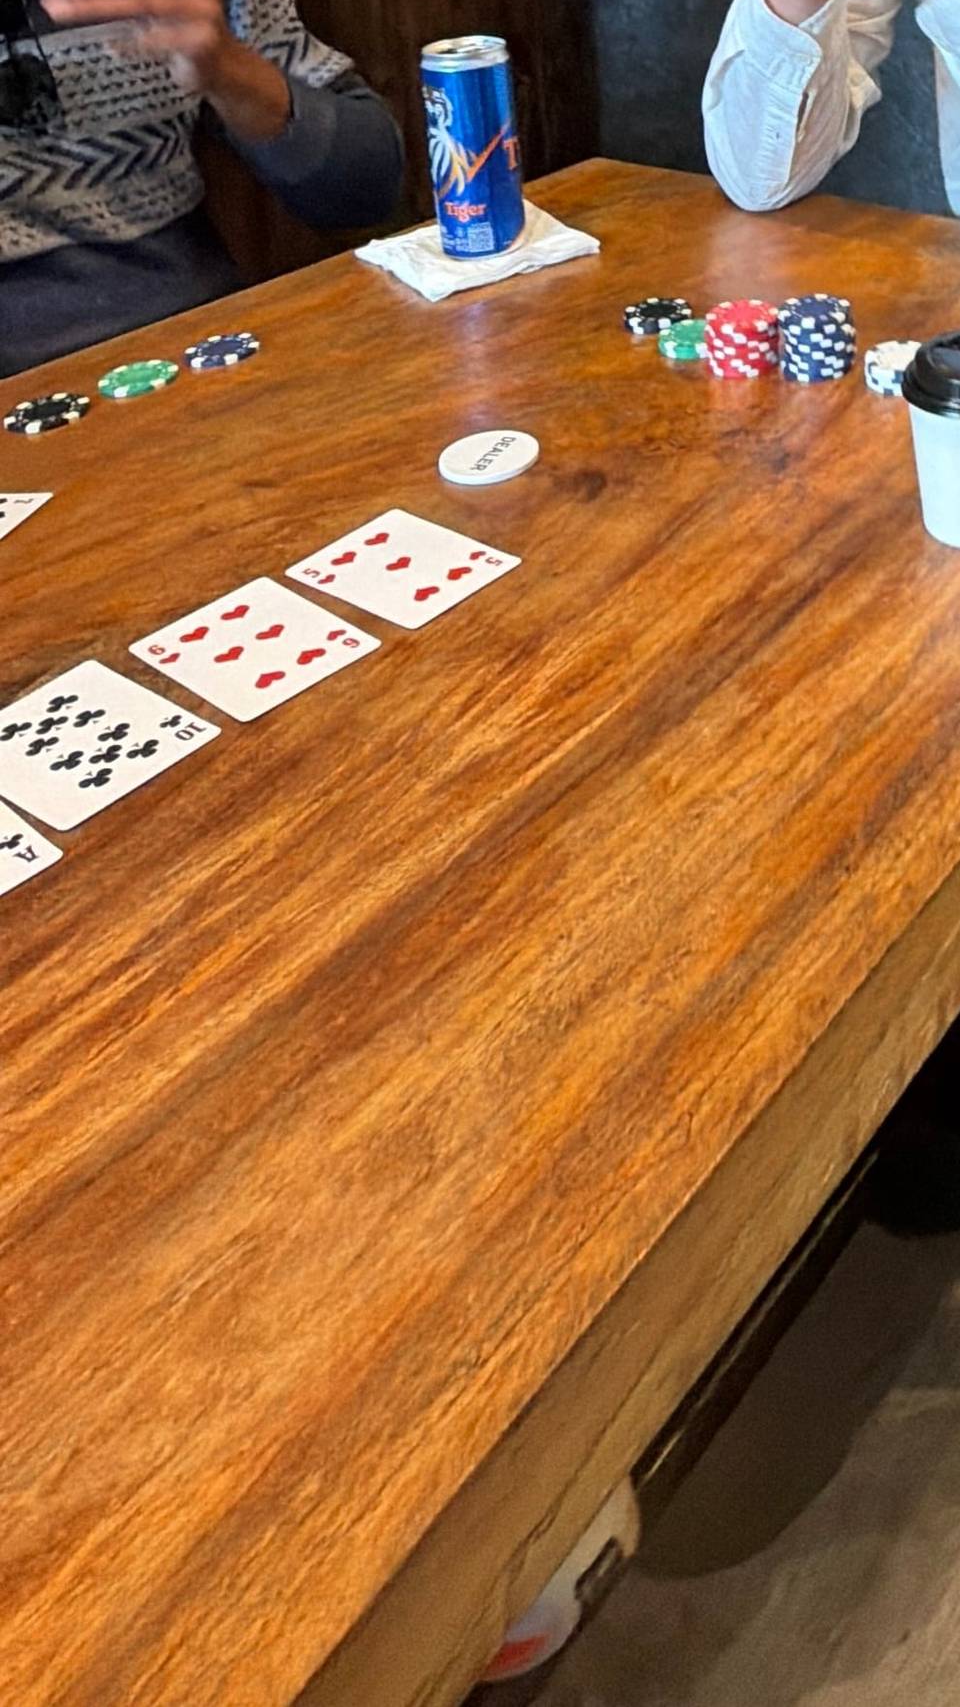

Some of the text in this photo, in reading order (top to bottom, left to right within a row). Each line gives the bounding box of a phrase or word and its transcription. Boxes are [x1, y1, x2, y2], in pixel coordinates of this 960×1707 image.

[444, 200, 487, 223] Tiger
[470, 436, 517, 471] DEALER
[485, 556, 503, 566] 5
[302, 567, 321, 579] 5
[148, 644, 166, 655] 6
[342, 637, 360, 648] 6
[174, 721, 207, 741] 10
[13, 844, 39, 863] A
